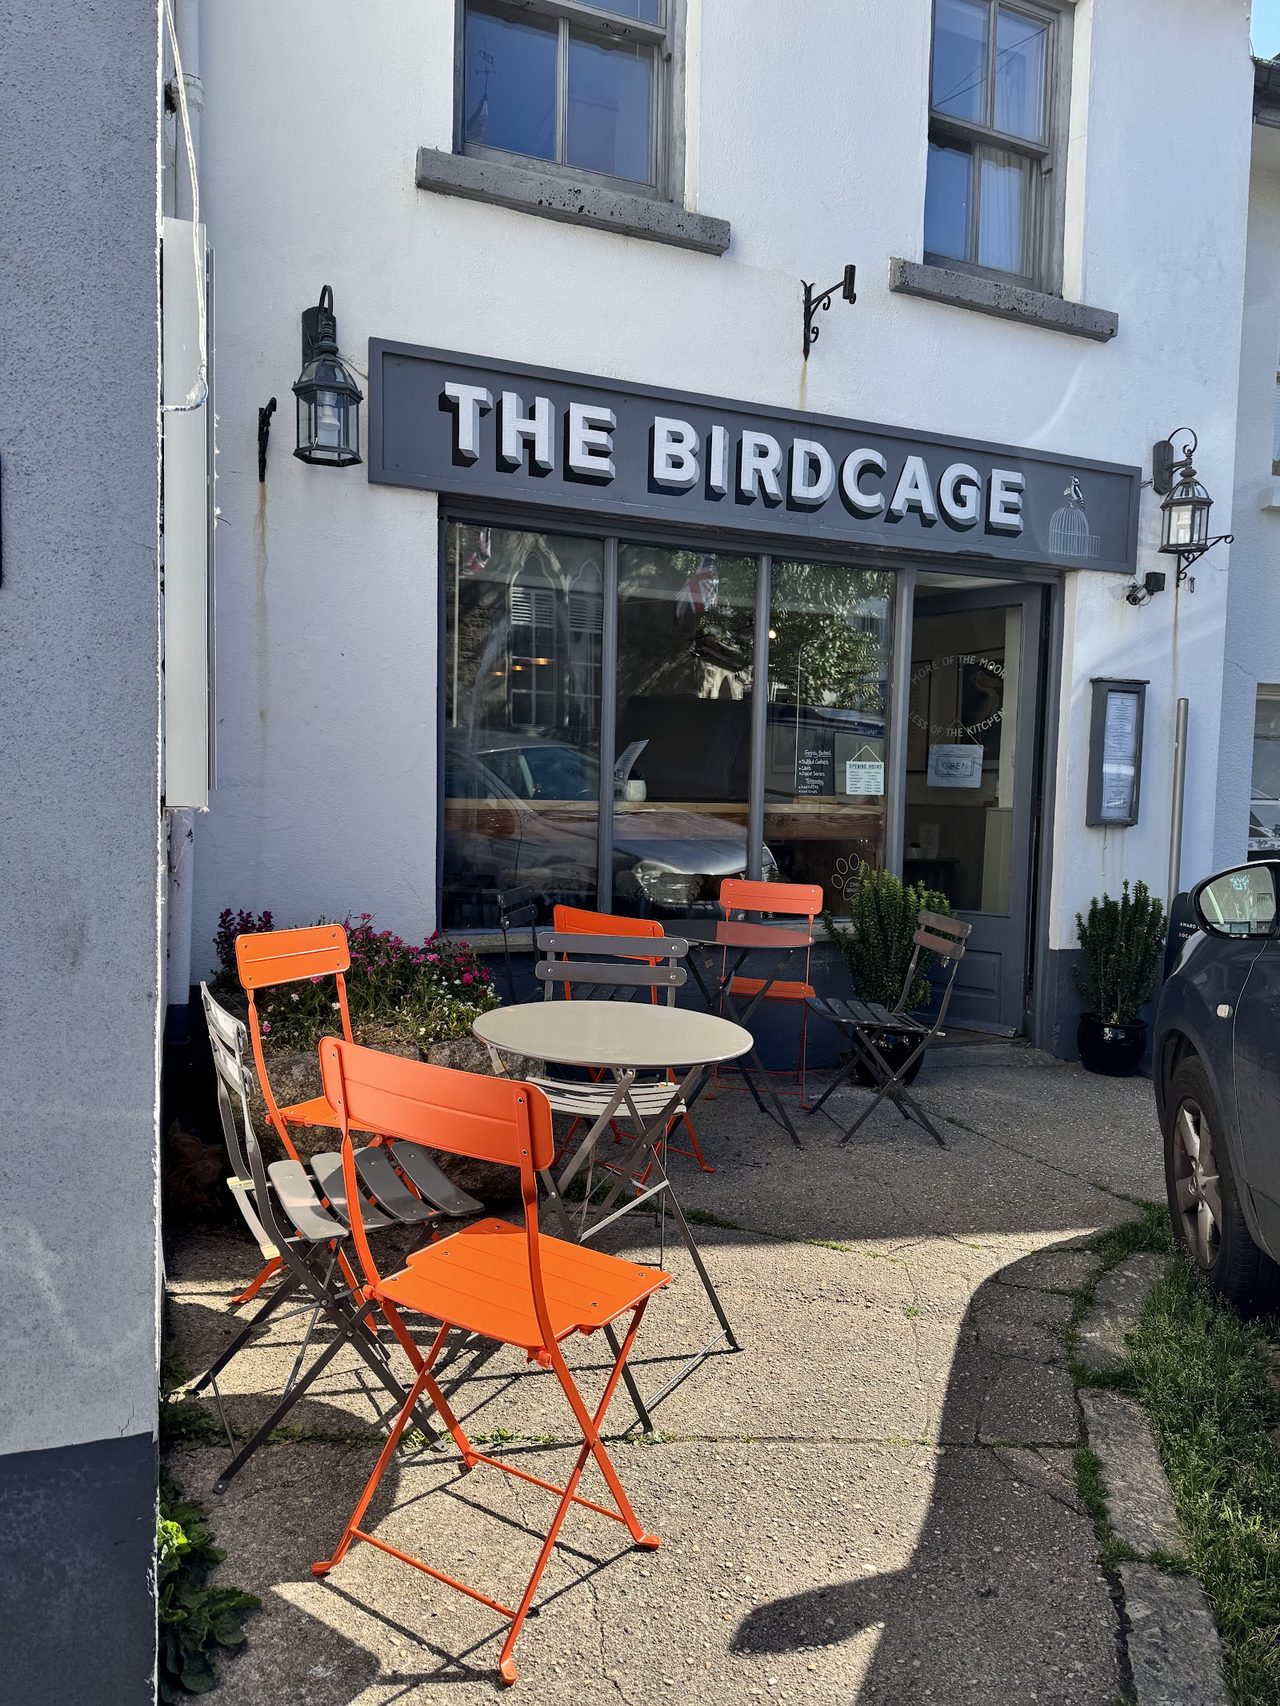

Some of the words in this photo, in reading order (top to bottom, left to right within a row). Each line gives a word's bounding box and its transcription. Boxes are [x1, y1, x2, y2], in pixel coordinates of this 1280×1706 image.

[441, 381, 617, 485] THE
[649, 416, 1026, 536] BIRDCAGE
[911, 661, 938, 685] MORE
[942, 655, 955, 666] OF
[957, 655, 976, 665] THE
[909, 711, 929, 730] LESS
[930, 724, 943, 736] OF
[946, 727, 963, 737] THE
[967, 707, 1007, 736] KITCHEN
